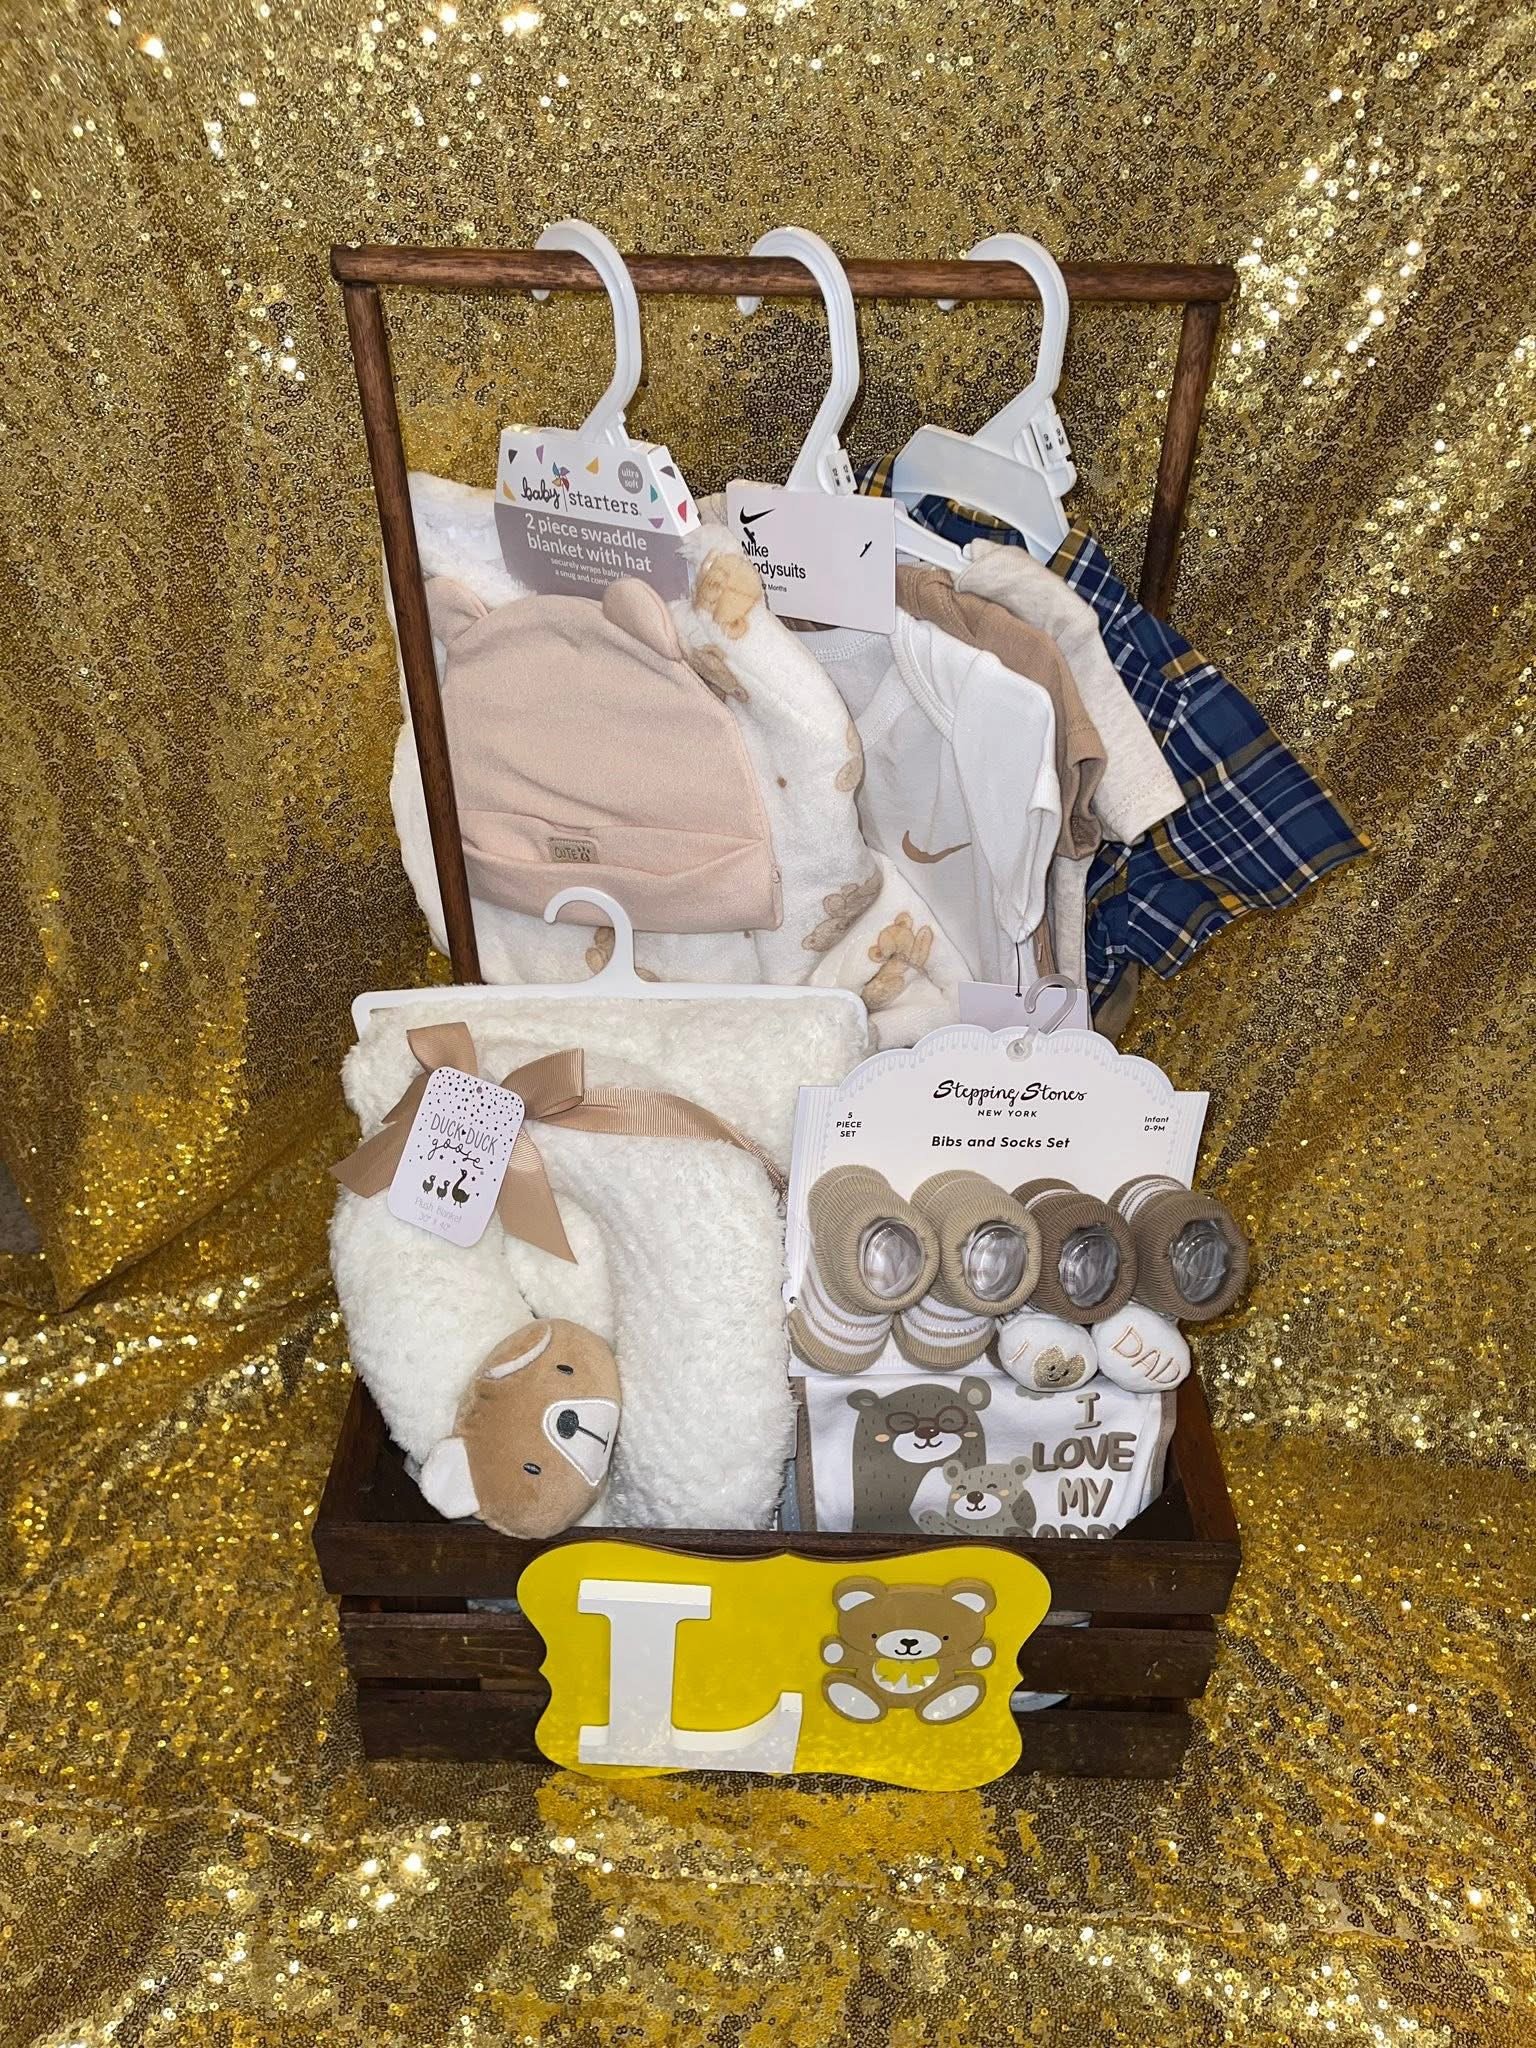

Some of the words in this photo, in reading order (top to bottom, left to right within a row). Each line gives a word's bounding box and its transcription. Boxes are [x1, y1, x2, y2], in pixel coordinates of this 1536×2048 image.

[621, 469, 640, 479] ultra
[624, 479, 640, 490] soft
[521, 476, 560, 509] baby
[569, 491, 639, 516] starters
[525, 513, 535, 529] 2
[538, 517, 578, 538] piece
[581, 527, 647, 550] swaddle
[527, 532, 583, 560] blanket
[586, 547, 622, 568] with
[624, 552, 653, 573] hat
[741, 540, 769, 558] Nike
[551, 558, 579, 570] securely
[580, 564, 602, 575] wraps
[602, 567, 619, 579] baby
[560, 570, 576, 581] snug
[577, 574, 590, 583] and
[753, 561, 806, 579] odysuits
[767, 584, 788, 592] Months
[555, 847, 578, 860] CUTE
[933, 1079, 1019, 1107] Stepping
[1021, 1082, 1087, 1101] Stones
[848, 1111, 853, 1119] 5
[977, 1109, 1002, 1117] NEW
[1008, 1110, 1038, 1118] YORK
[840, 1130, 856, 1138] SET
[931, 1136, 962, 1147] Bibs
[967, 1136, 996, 1148] and
[1000, 1137, 1042, 1148] Socks
[1047, 1137, 1070, 1149] Set
[428, 1139, 484, 1169] goose
[1111, 1324, 1181, 1384] DAD
[1075, 1392, 1101, 1430] I
[1033, 1431, 1137, 1472] LOVE
[1058, 1477, 1113, 1517] MY
[578, 1578, 803, 1773] L
